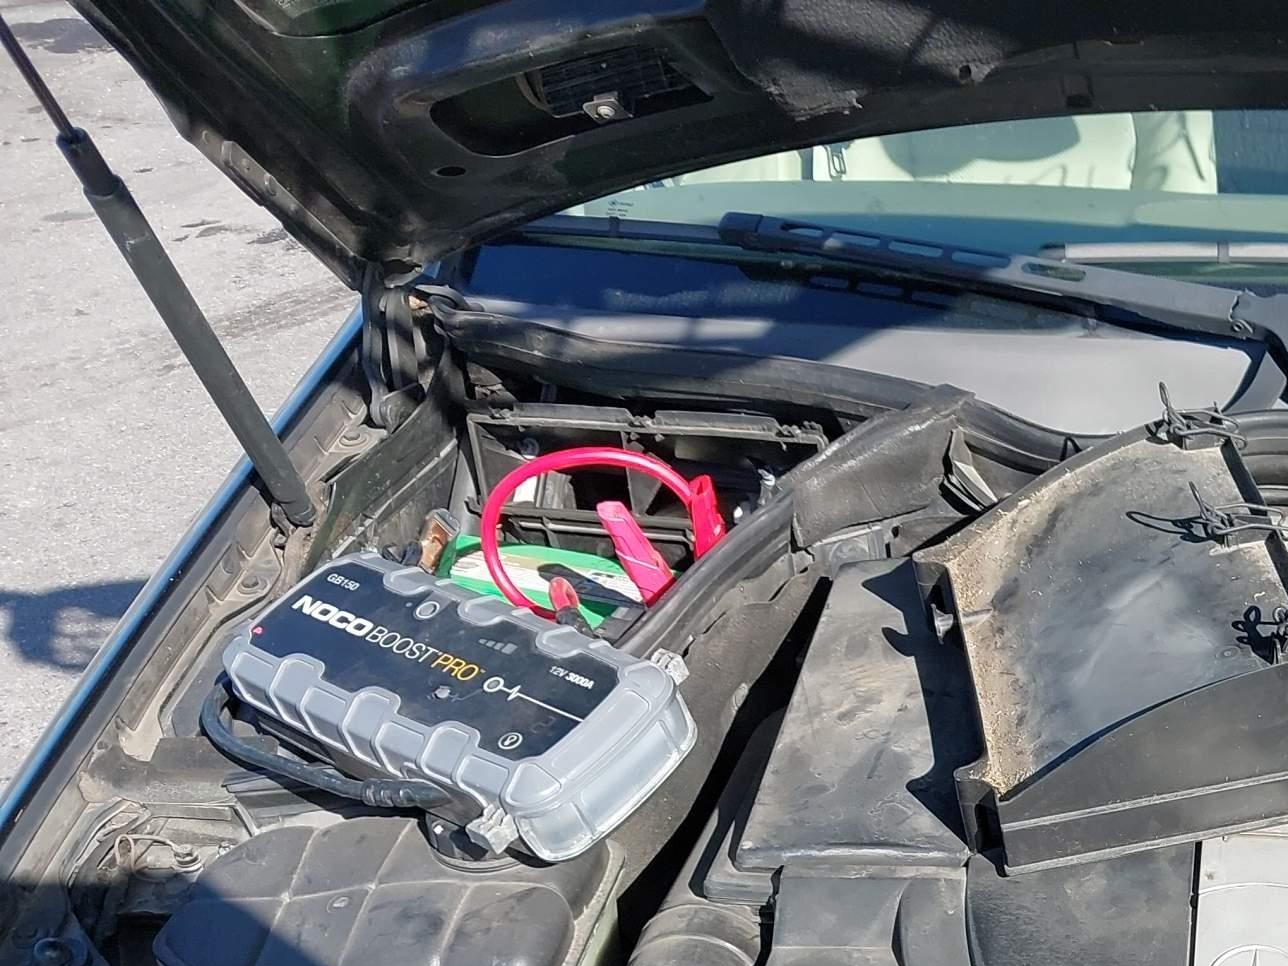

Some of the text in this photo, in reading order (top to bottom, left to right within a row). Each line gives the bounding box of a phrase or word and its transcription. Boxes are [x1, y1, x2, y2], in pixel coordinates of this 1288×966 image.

[327, 574, 360, 591] GB150
[292, 595, 479, 680] NOCO BOOST PRO
[550, 666, 568, 677] 12V
